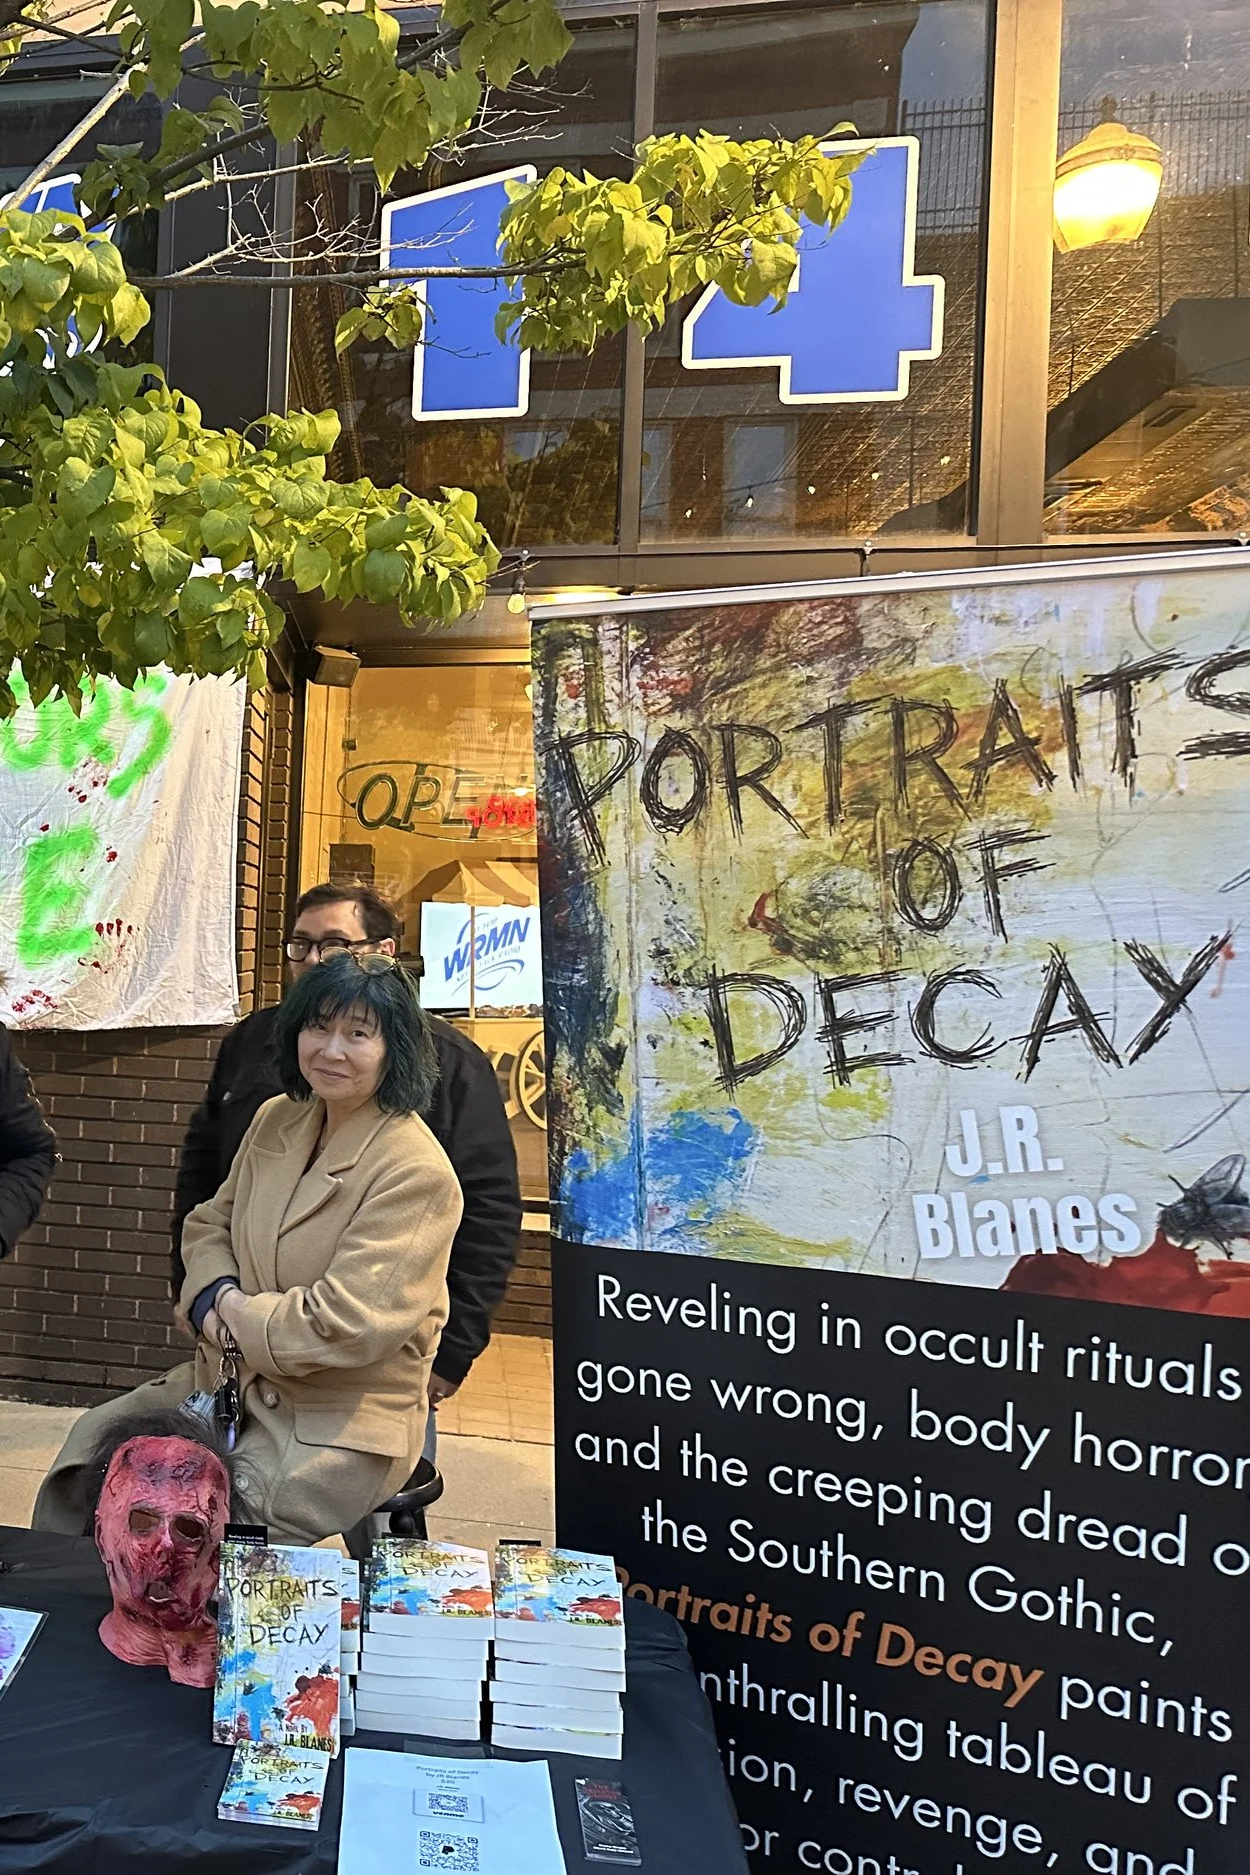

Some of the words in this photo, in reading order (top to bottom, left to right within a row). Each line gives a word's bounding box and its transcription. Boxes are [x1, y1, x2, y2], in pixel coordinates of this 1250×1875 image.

[542, 648, 1250, 866] PORTRAITS
[891, 829, 1054, 944] OF
[444, 917, 531, 982] WRMN
[703, 928, 1234, 1100] DECAY
[945, 1105, 1064, 1177] J.R.
[913, 1193, 1142, 1261] Blanes
[598, 1274, 796, 1354] Reveling
[821, 1302, 861, 1348] in
[885, 1319, 1044, 1373] occult
[1066, 1336, 1242, 1401] rituals
[577, 1361, 692, 1402] gone
[710, 1379, 884, 1442] wrong,
[911, 1388, 1050, 1470] body
[1074, 1411, 1250, 1489] horror
[575, 1425, 660, 1471] and
[680, 1432, 748, 1487] the
[768, 1465, 992, 1544] creeping
[1017, 1490, 1187, 1567] dread
[1213, 1543, 1250, 1576] o
[226, 1577, 339, 1600] PORTRAITS
[378, 1550, 485, 1565] PORTRAITS
[402, 1566, 479, 1579] DECAY
[504, 1557, 612, 1572] PORTRAITS
[527, 1573, 605, 1587] DECAY
[642, 1499, 707, 1553] the
[727, 1518, 945, 1603] Southern
[967, 1564, 1175, 1657] Gothic,
[248, 1623, 329, 1645] DECAY
[280, 1603, 303, 1621] OF
[808, 1610, 864, 1657] of
[876, 1622, 1046, 1709] Decay
[1060, 1676, 1233, 1742] paints
[285, 1724, 299, 1733] NOVEL
[301, 1724, 307, 1733] BY
[300, 1735, 332, 1752] BLANES
[700, 1663, 923, 1762] nthralling
[946, 1720, 1151, 1804] tableau
[1177, 1774, 1238, 1825] of
[241, 1756, 324, 1769] PORTRAITS
[254, 1773, 314, 1784] DECAY
[838, 1777, 1058, 1868] revenge,
